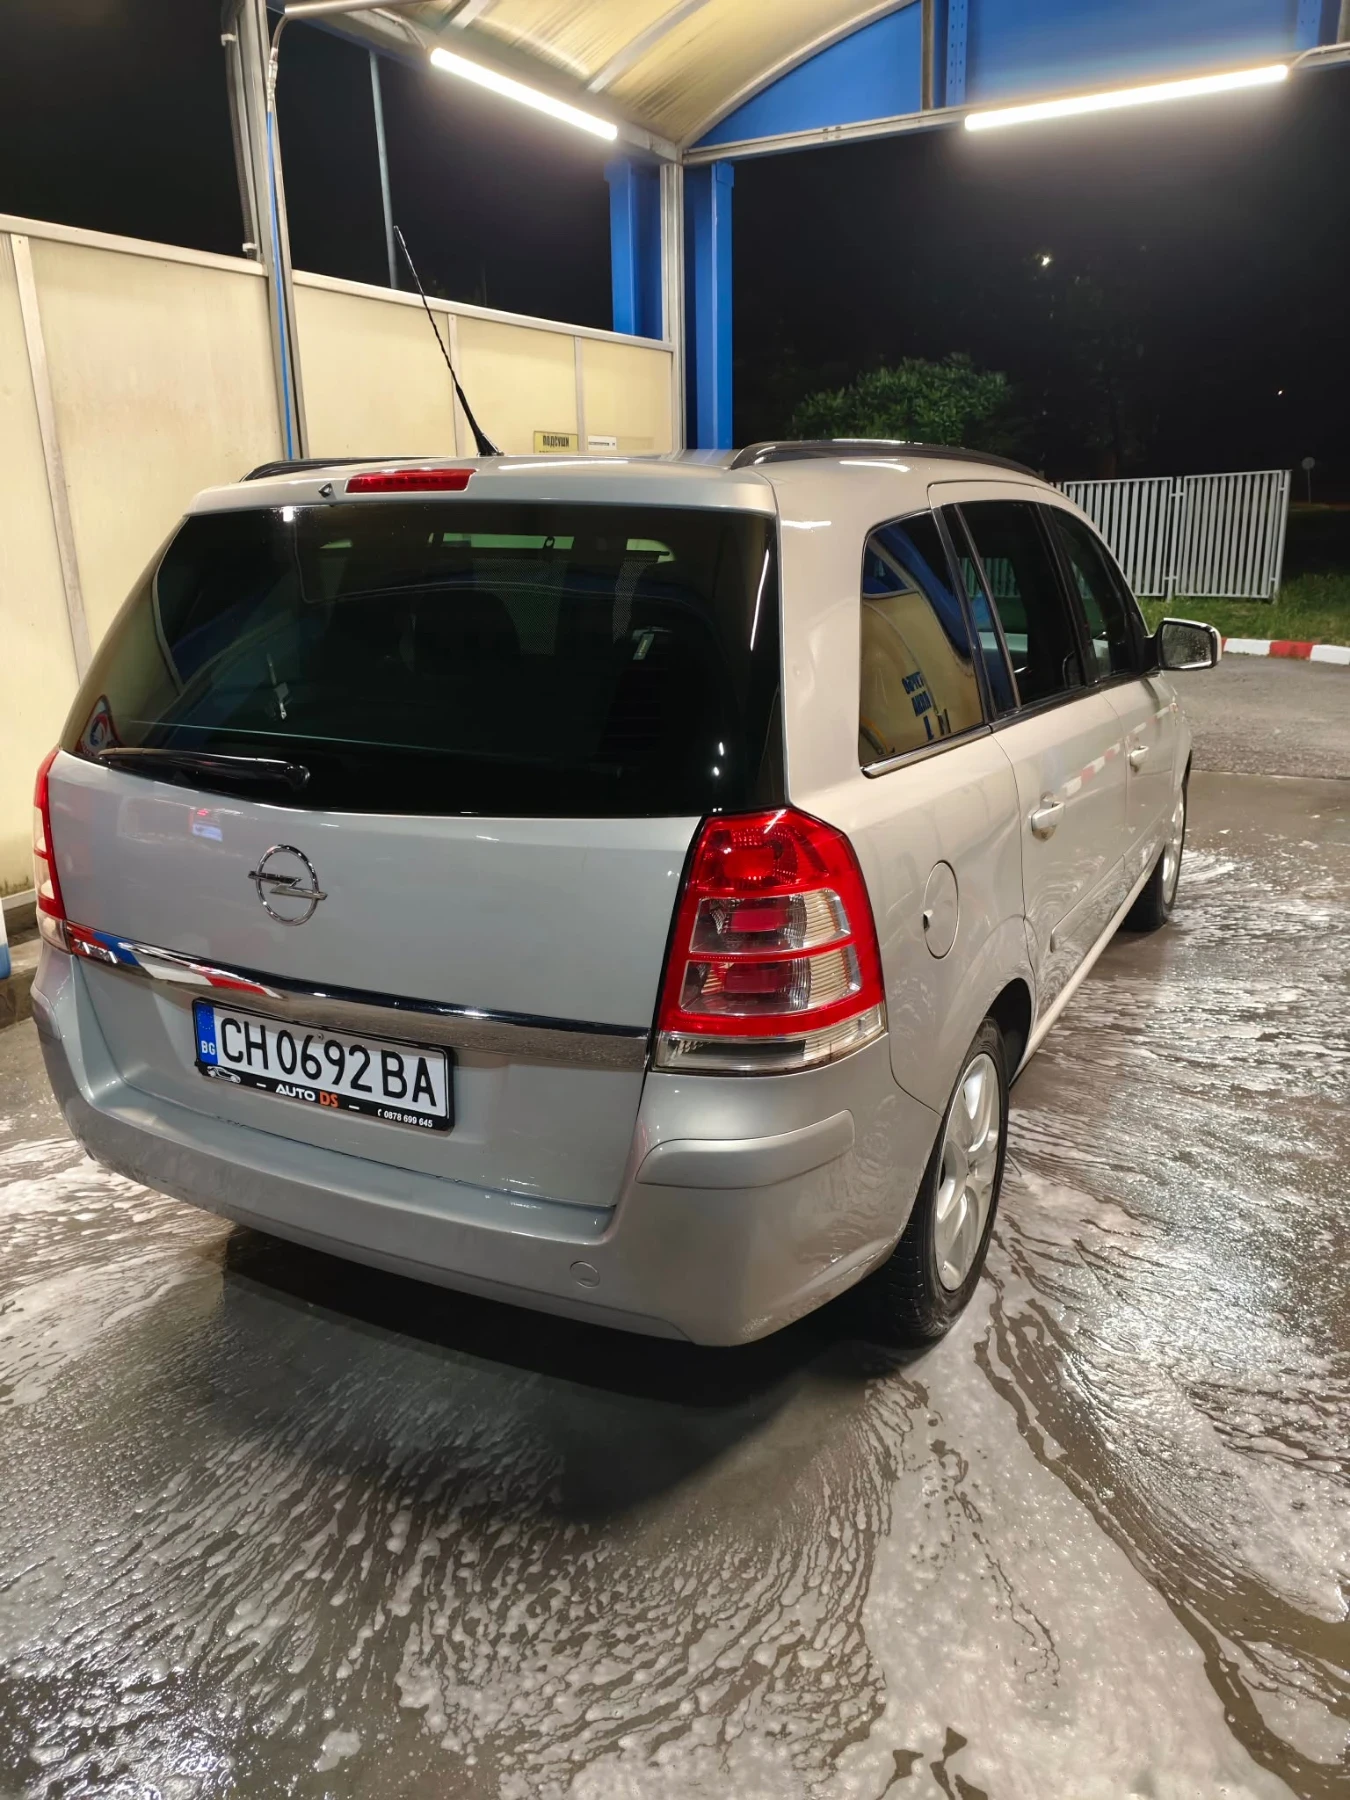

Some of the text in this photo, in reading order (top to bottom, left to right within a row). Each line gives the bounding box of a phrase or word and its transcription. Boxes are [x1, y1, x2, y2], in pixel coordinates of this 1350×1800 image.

[201, 1040, 216, 1056] BG
[276, 1083, 339, 1108] AUTO DS
[383, 1110, 402, 1121] 0878
[418, 1117, 433, 1128] 645
